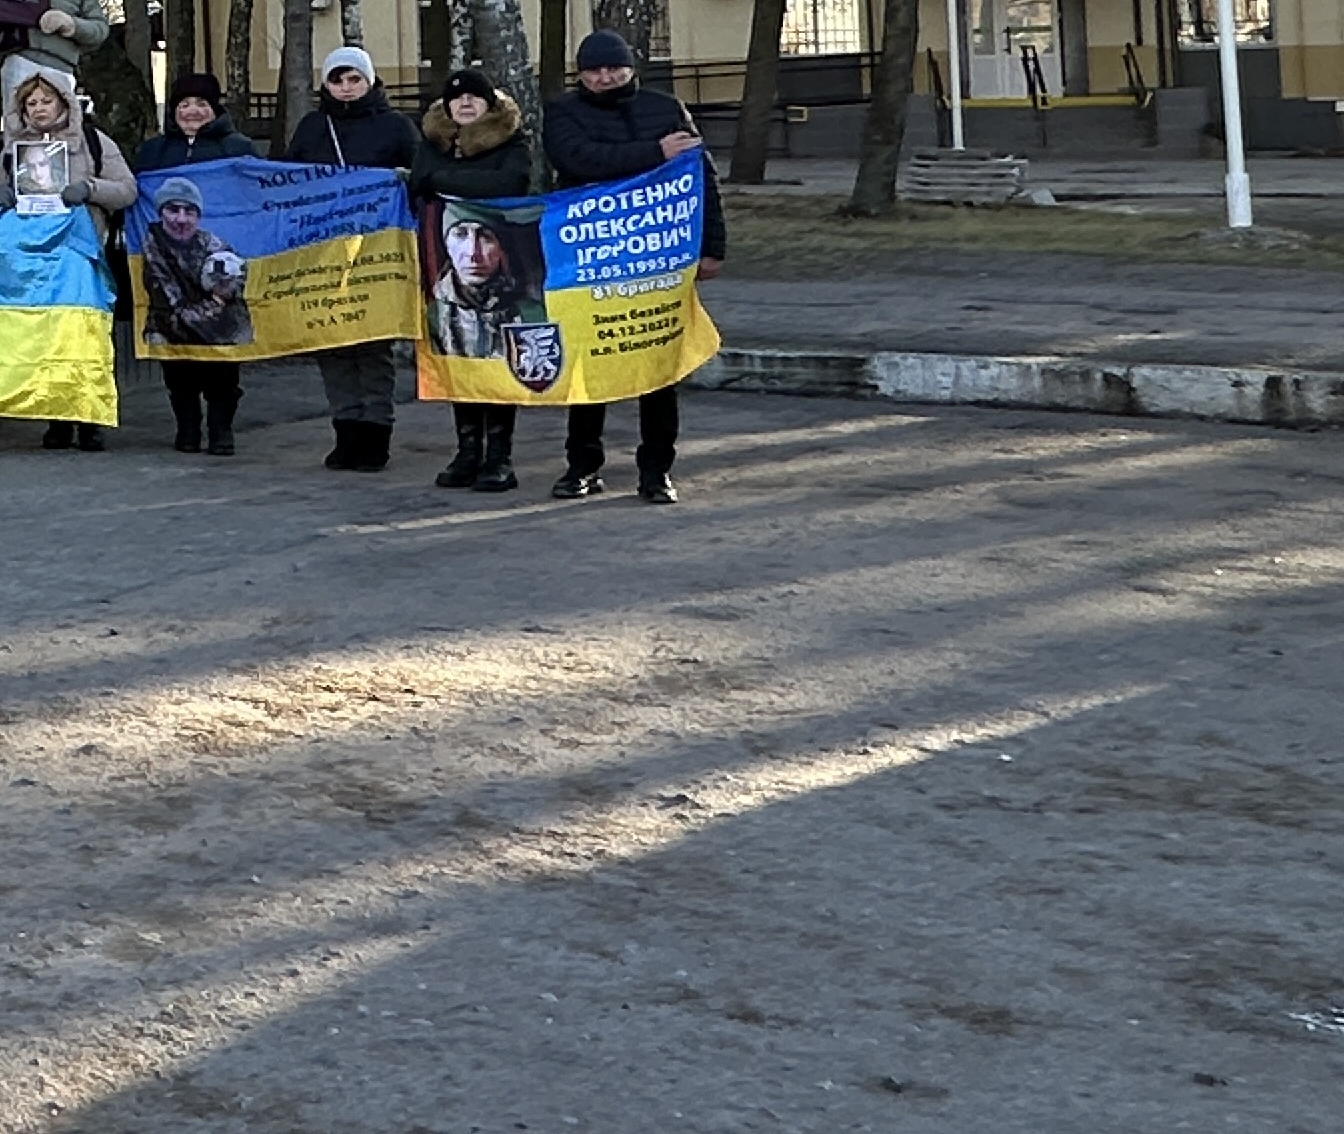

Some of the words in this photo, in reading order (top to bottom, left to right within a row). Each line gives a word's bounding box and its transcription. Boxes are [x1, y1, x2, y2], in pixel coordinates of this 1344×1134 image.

[566, 174, 694, 219] КРОТЕНКО
[559, 196, 699, 243] ОЛЕКСАНДР
[576, 224, 692, 266] ІГОРОВИЧ
[576, 255, 667, 282] 23.05.1995
